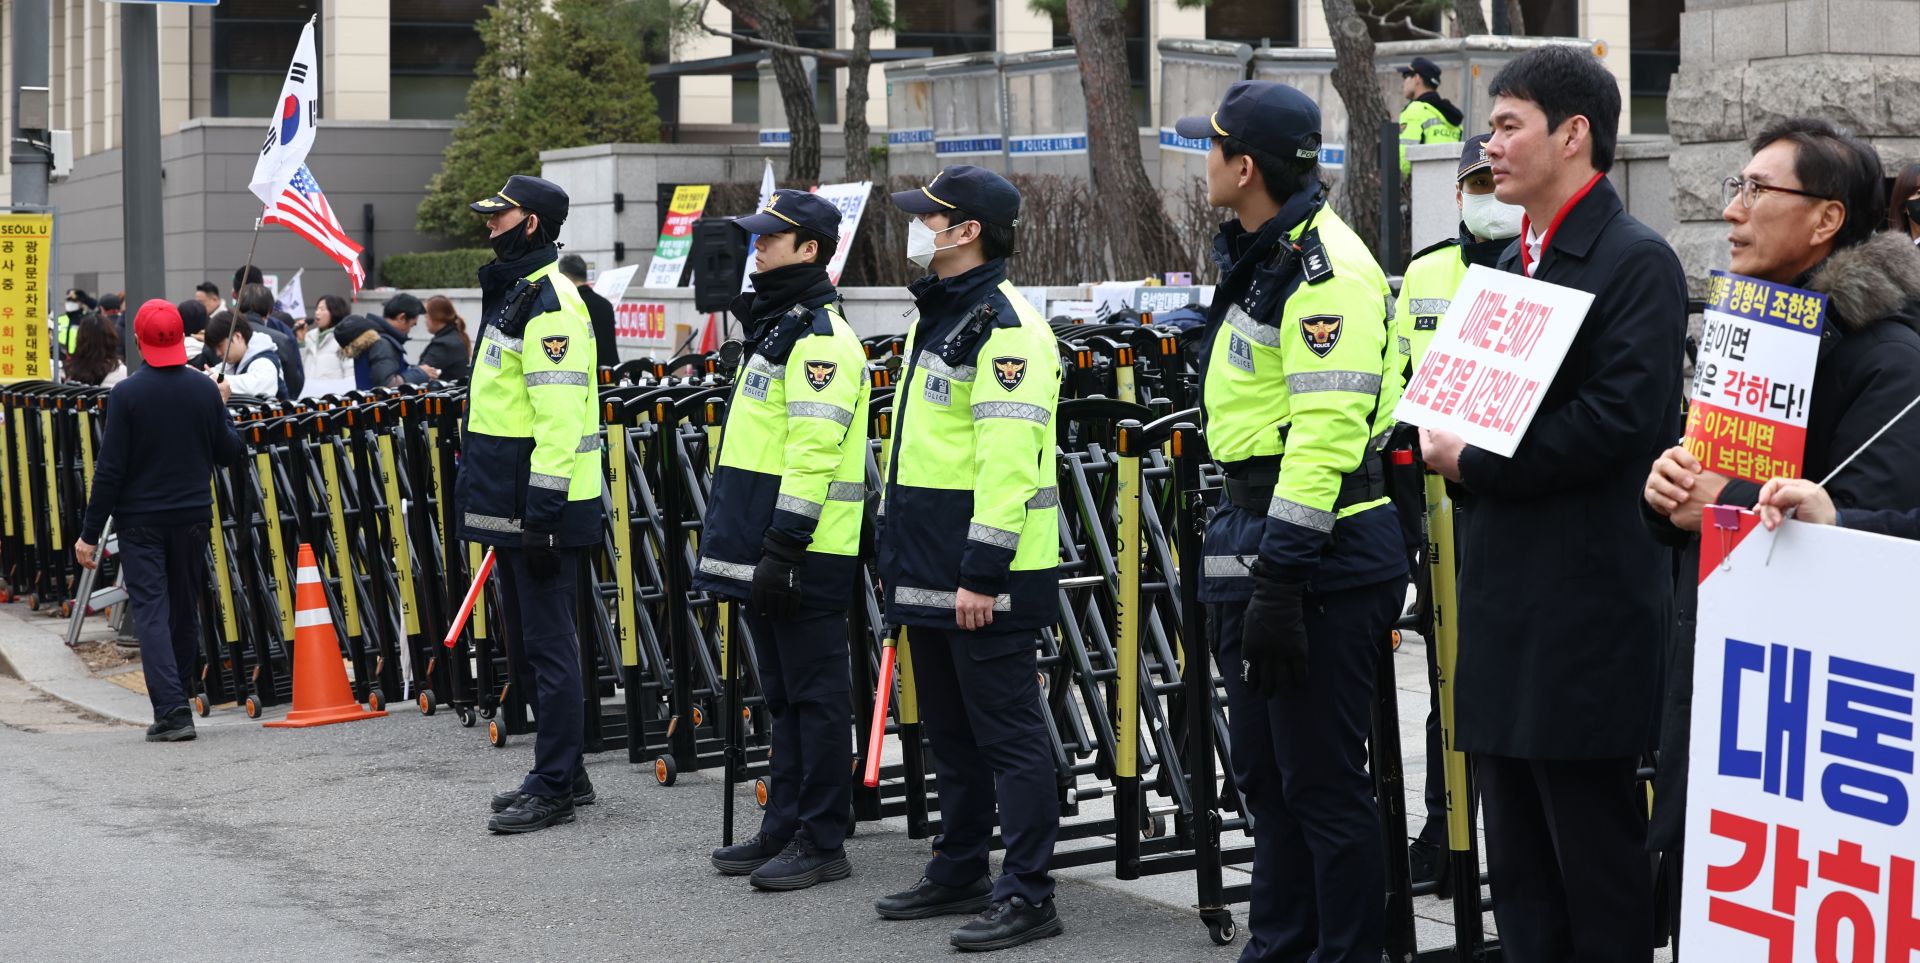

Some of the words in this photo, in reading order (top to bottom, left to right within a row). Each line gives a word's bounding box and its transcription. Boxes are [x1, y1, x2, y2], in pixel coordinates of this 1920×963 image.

[897, 131, 920, 142] POLICE
[944, 141, 975, 152] POLICE
[1022, 140, 1051, 151] POLICE
[1053, 138, 1073, 150] LINE
[1172, 134, 1202, 149] POLICE
[1, 225, 35, 234] SEOUL
[2, 241, 14, 291] 공사중
[24, 241, 38, 318] 광화문교차로
[1729, 280, 1770, 317] 정형식
[1769, 290, 1821, 330] 조한창
[1458, 288, 1507, 350] 이제는
[2, 307, 14, 376] 우회바람
[1231, 335, 1250, 359] 경찰
[1700, 318, 1751, 362] 법이면
[1229, 353, 1251, 369] POLICE
[744, 386, 765, 398] POLICE
[747, 372, 767, 389] 경찰
[926, 375, 948, 394] 경찰
[924, 390, 948, 402] POLICE
[1406, 350, 1451, 406] 바로
[1430, 356, 1477, 416] 잡을
[1457, 365, 1541, 436] 시간입니다
[1723, 368, 1805, 419] 각하다!
[1704, 411, 1775, 453] 이겨내면
[1718, 637, 1915, 827] 대통
